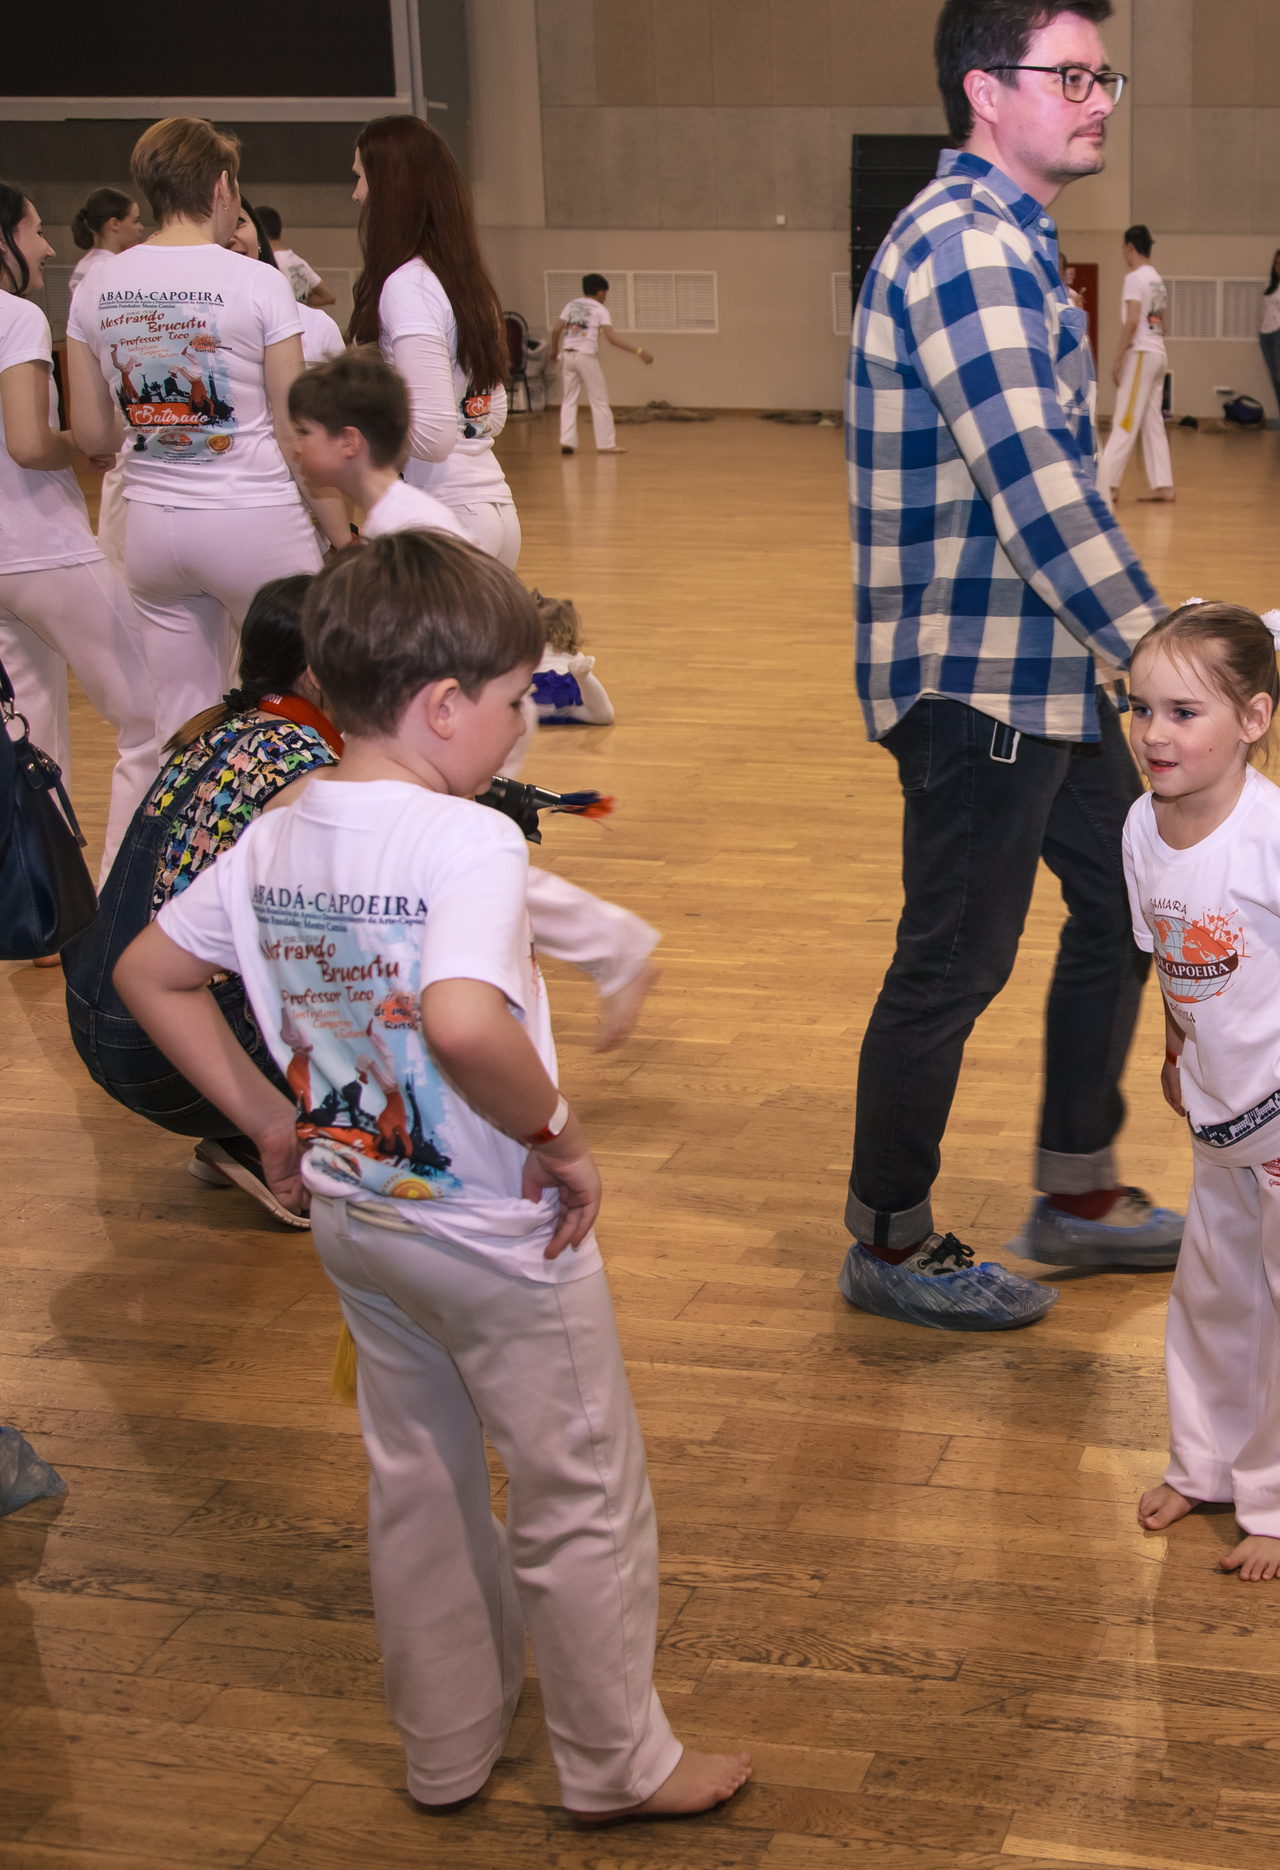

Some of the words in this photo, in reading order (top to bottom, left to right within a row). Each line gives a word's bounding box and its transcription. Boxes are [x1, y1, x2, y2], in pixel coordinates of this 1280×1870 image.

[99, 288, 225, 304] ABADÁ-CAPOEIRA
[100, 309, 165, 331] Mestrando
[146, 316, 207, 333] Brucutu
[119, 335, 163, 347] Professor
[252, 884, 428, 918] ABADÁ-CAPOEIRA
[316, 954, 400, 983] Brucutu
[280, 987, 342, 1006] Professor
